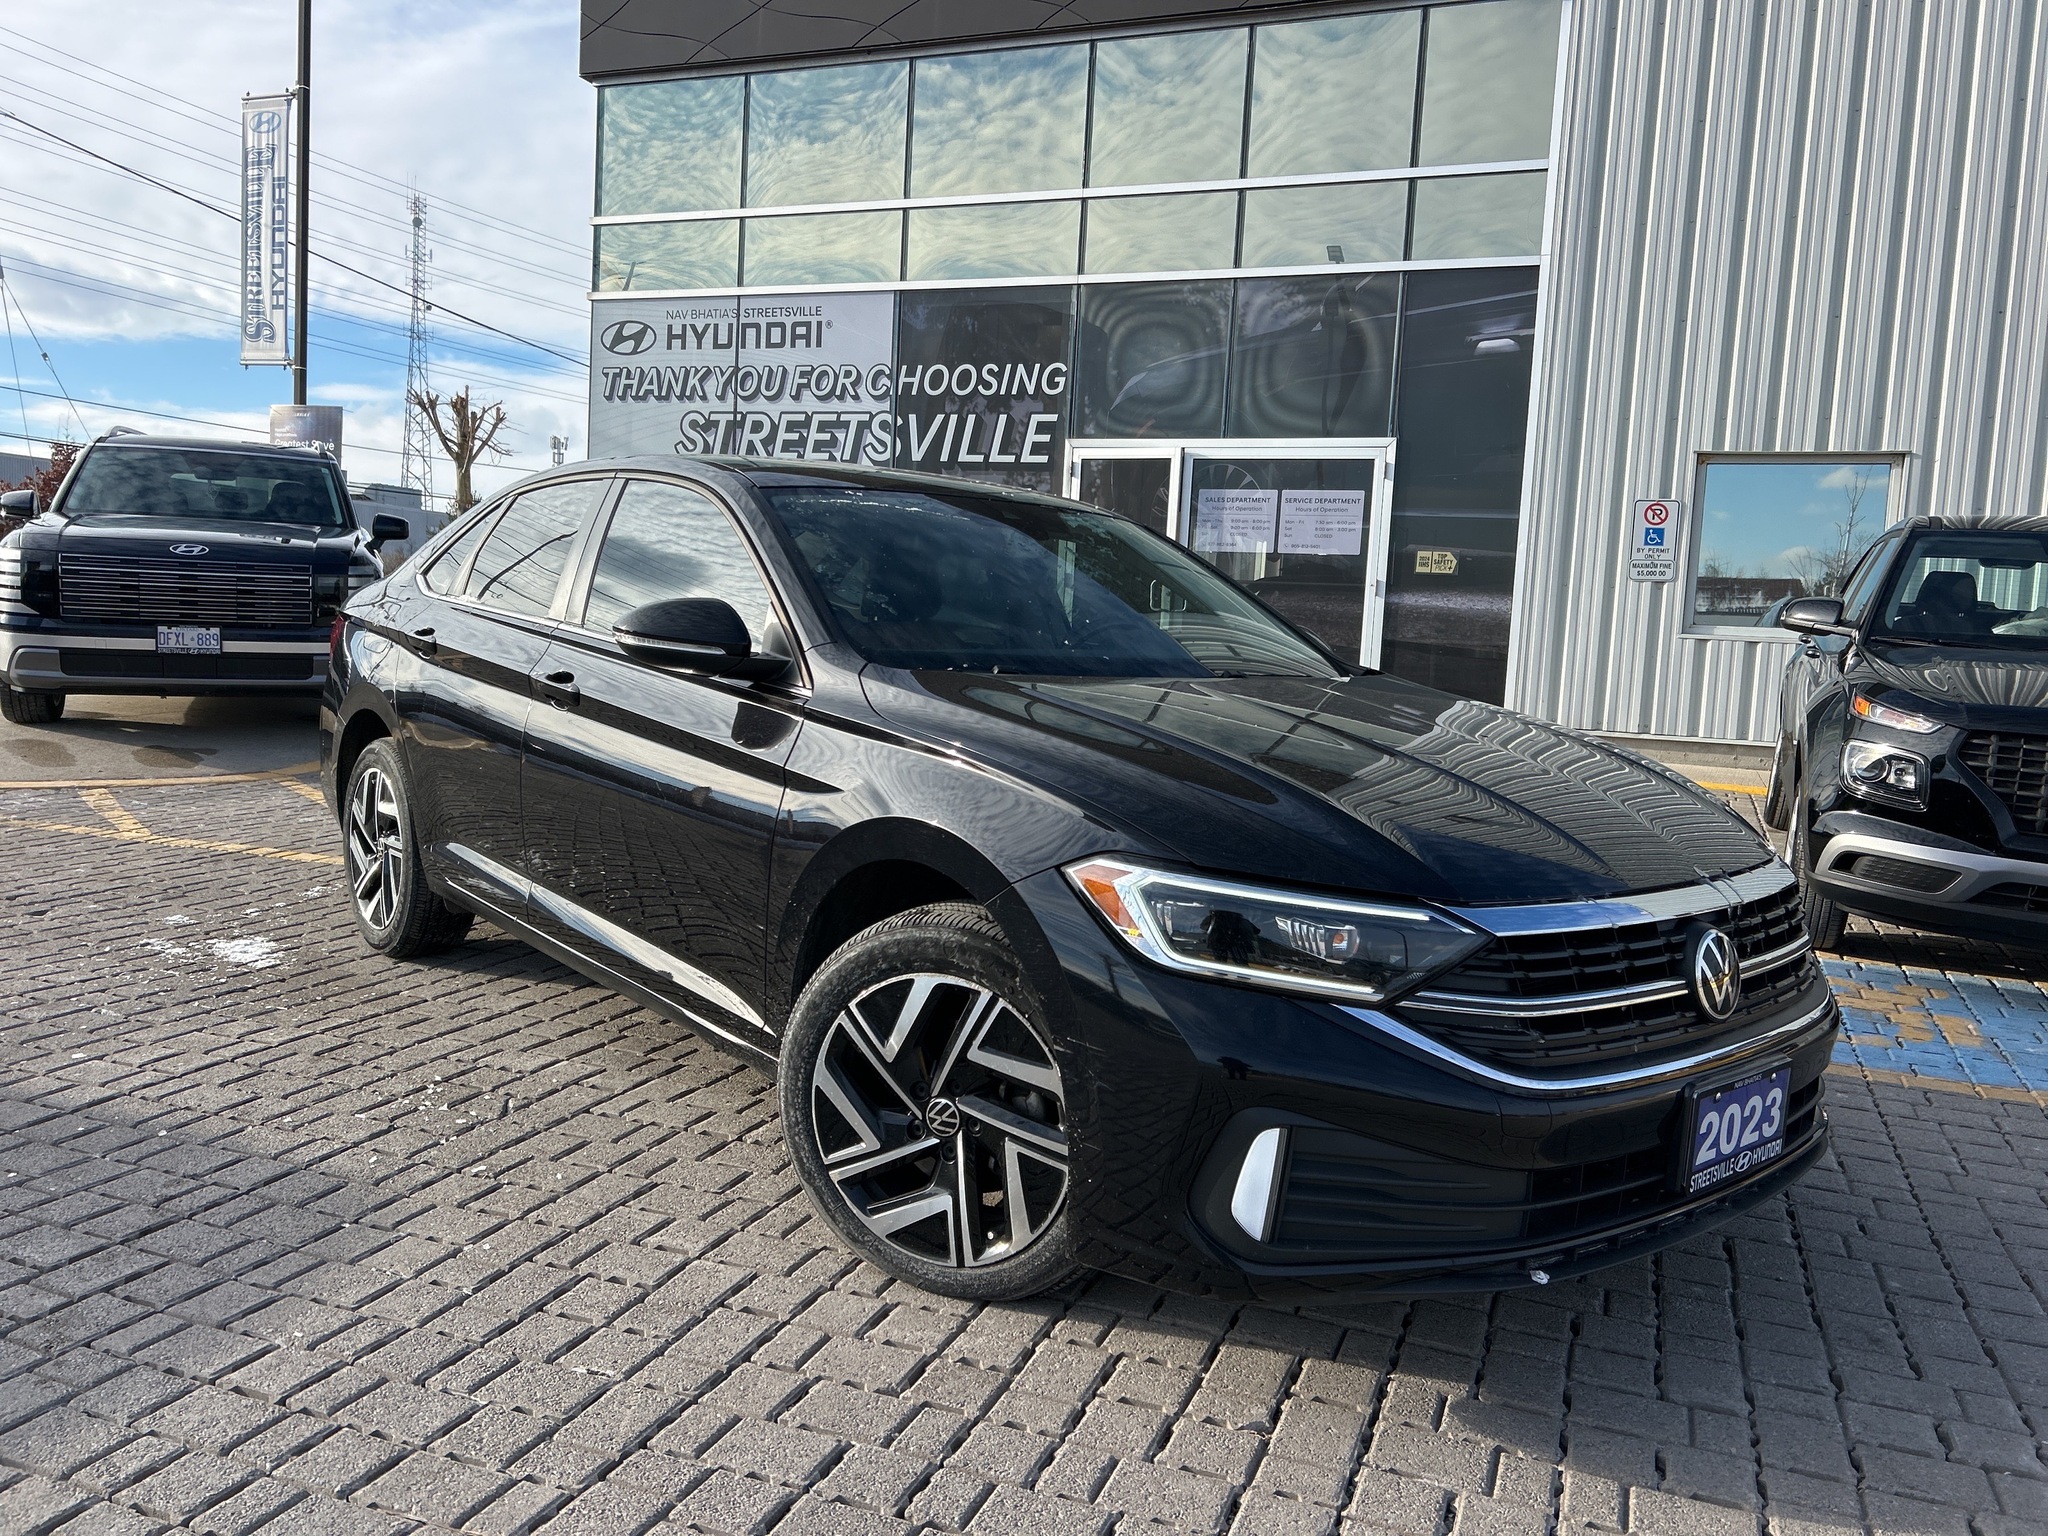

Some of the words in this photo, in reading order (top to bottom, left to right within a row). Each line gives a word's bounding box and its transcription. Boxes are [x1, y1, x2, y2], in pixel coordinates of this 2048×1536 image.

[245, 143, 278, 343] STREETSVILLE
[272, 175, 285, 310] HYUNDAI
[666, 309, 688, 320] NAV
[690, 308, 738, 320] BHATIA'S
[743, 306, 822, 318] STREETSVILLE
[602, 366, 712, 403] THANK
[712, 365, 789, 403] YOU
[790, 364, 863, 402] FOR
[865, 363, 1068, 399] CHOOSING
[311, 439, 335, 451] Sve
[674, 410, 1058, 464] STREETSVILLE
[1235, 505, 1263, 513] Operation
[158, 631, 188, 646] DFXL
[196, 632, 219, 647] 889
[1695, 1087, 1782, 1166] 2023
[1689, 1158, 1735, 1193] STREETSVILLE
[1752, 1138, 1783, 1165] HYUNDAI
